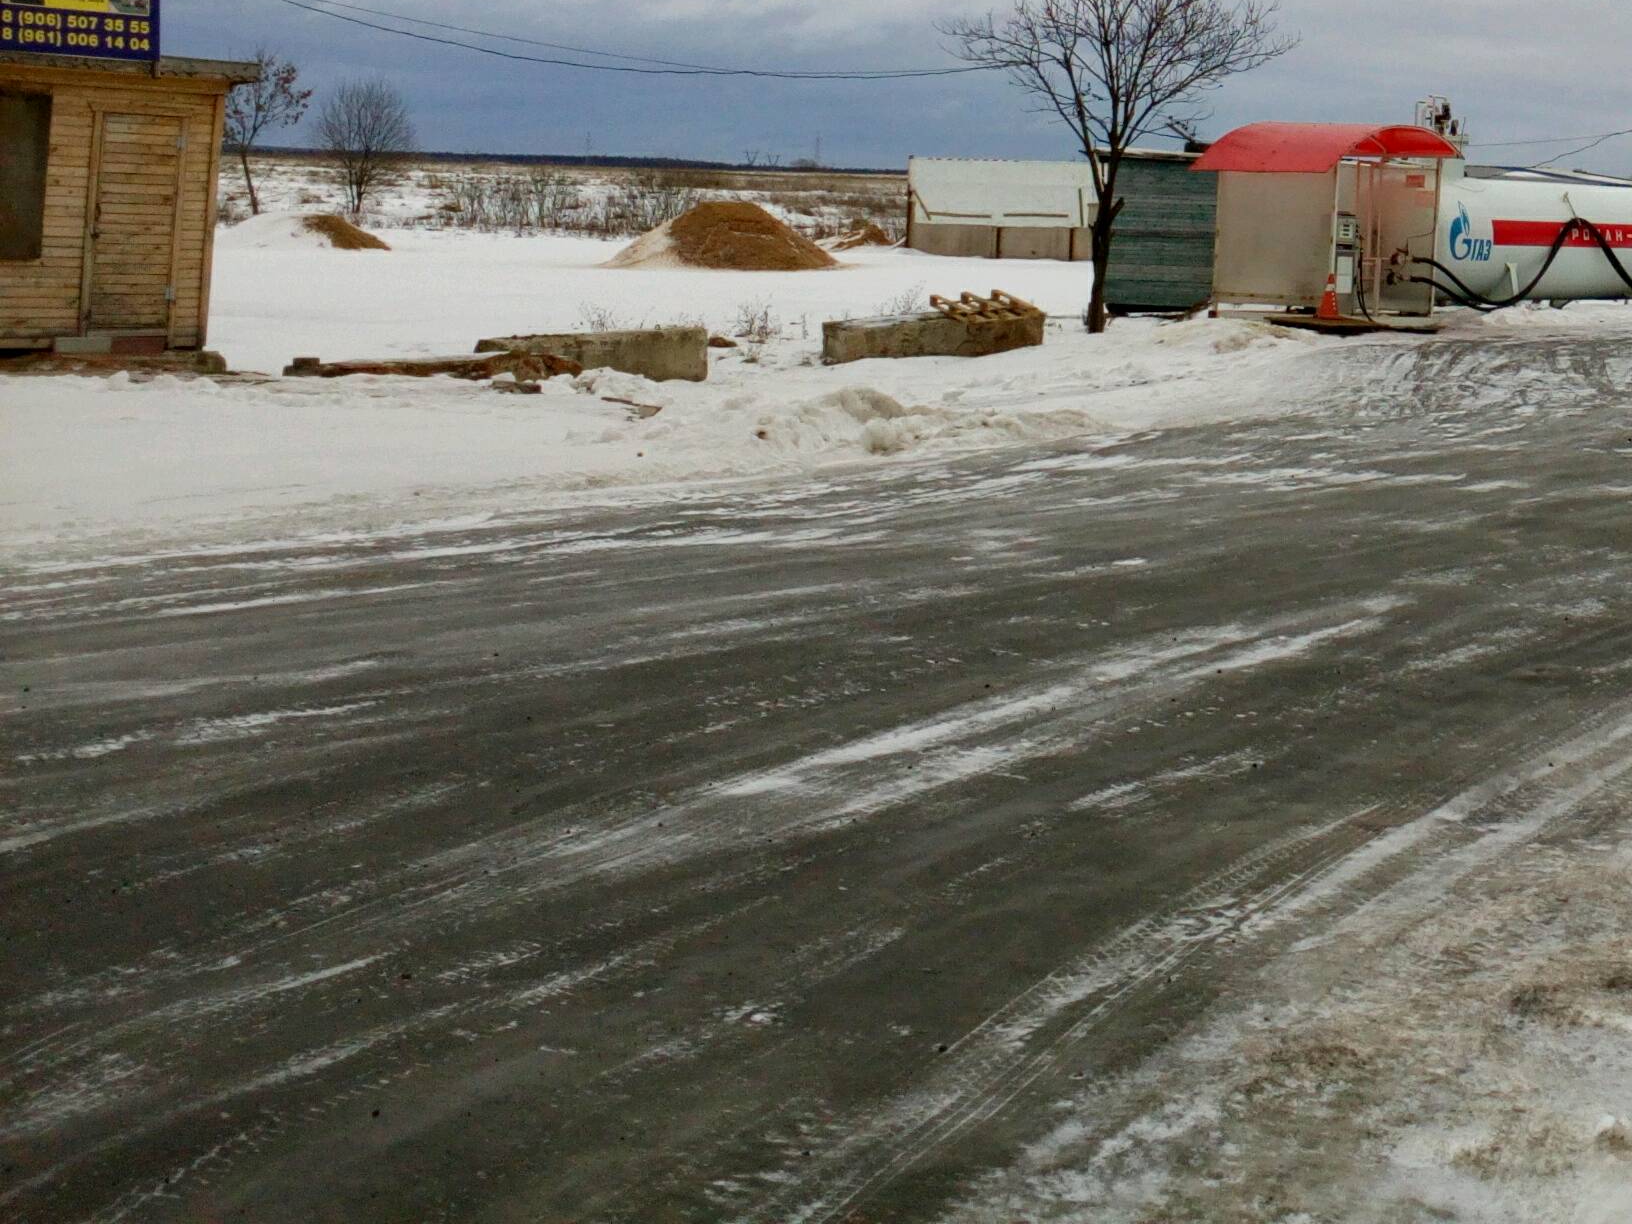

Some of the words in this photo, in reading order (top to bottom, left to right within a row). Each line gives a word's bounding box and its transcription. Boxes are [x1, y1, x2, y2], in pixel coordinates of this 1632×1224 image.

[2, 10, 13, 23] 8
[18, 11, 61, 29] (906)
[67, 15, 98, 29] 507
[104, 18, 124, 32] 35
[129, 21, 150, 34] 55
[2, 27, 13, 40] 8
[18, 29, 61, 47] (961)
[67, 32, 99, 47] 006
[105, 36, 125, 50] 14
[129, 37, 150, 51] 04
[1471, 239, 1492, 261] ГАЗ
